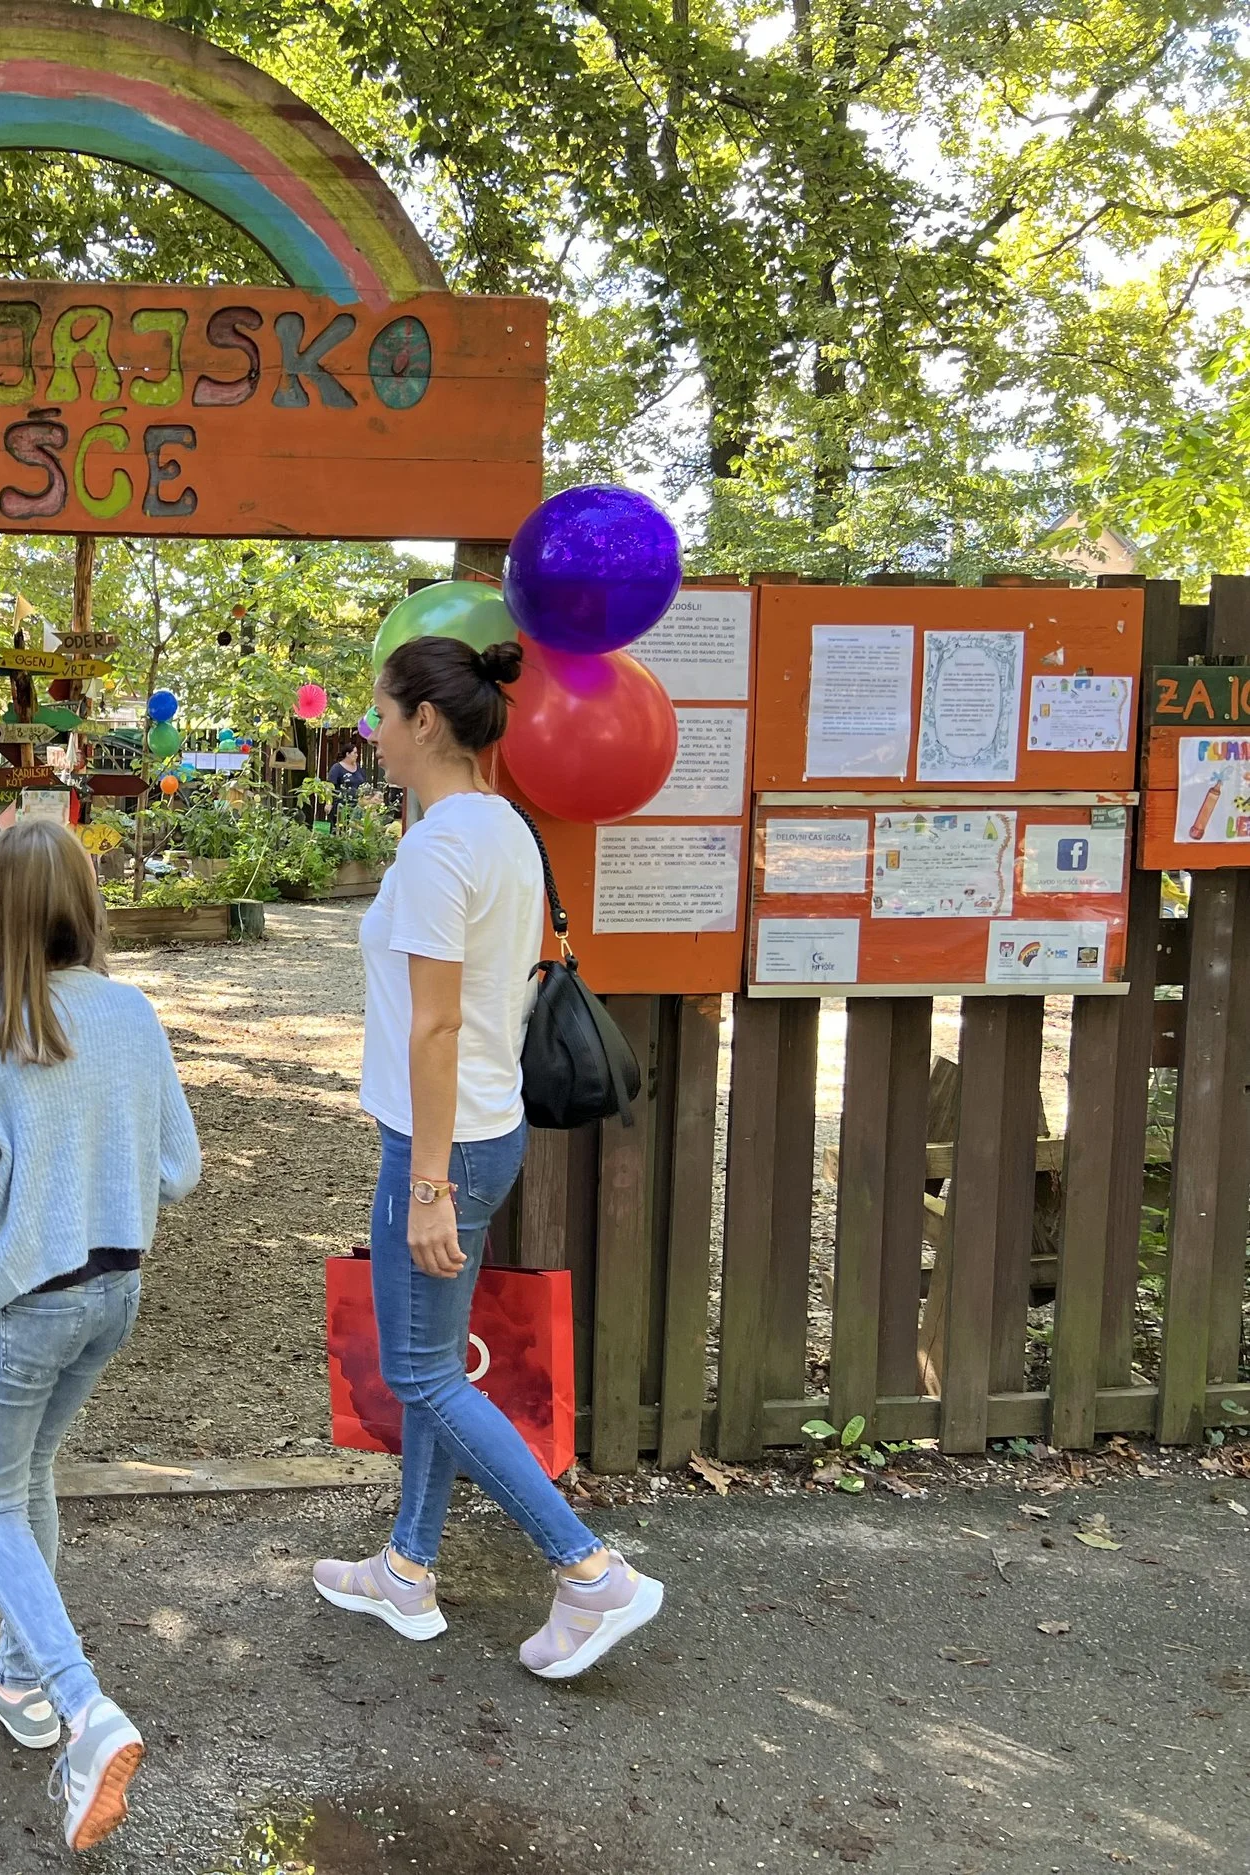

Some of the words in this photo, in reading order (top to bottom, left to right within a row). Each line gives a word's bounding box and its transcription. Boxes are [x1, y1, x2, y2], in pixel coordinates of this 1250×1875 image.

[669, 602, 702, 611] ODOŠLI!
[64, 634, 104, 649] ODER
[15, 655, 54, 669] OGENJ
[62, 664, 86, 676] VRT
[1156, 678, 1215, 721] ZA
[6, 778, 24, 787] KOT
[824, 833, 852, 842] IGRIŠČA
